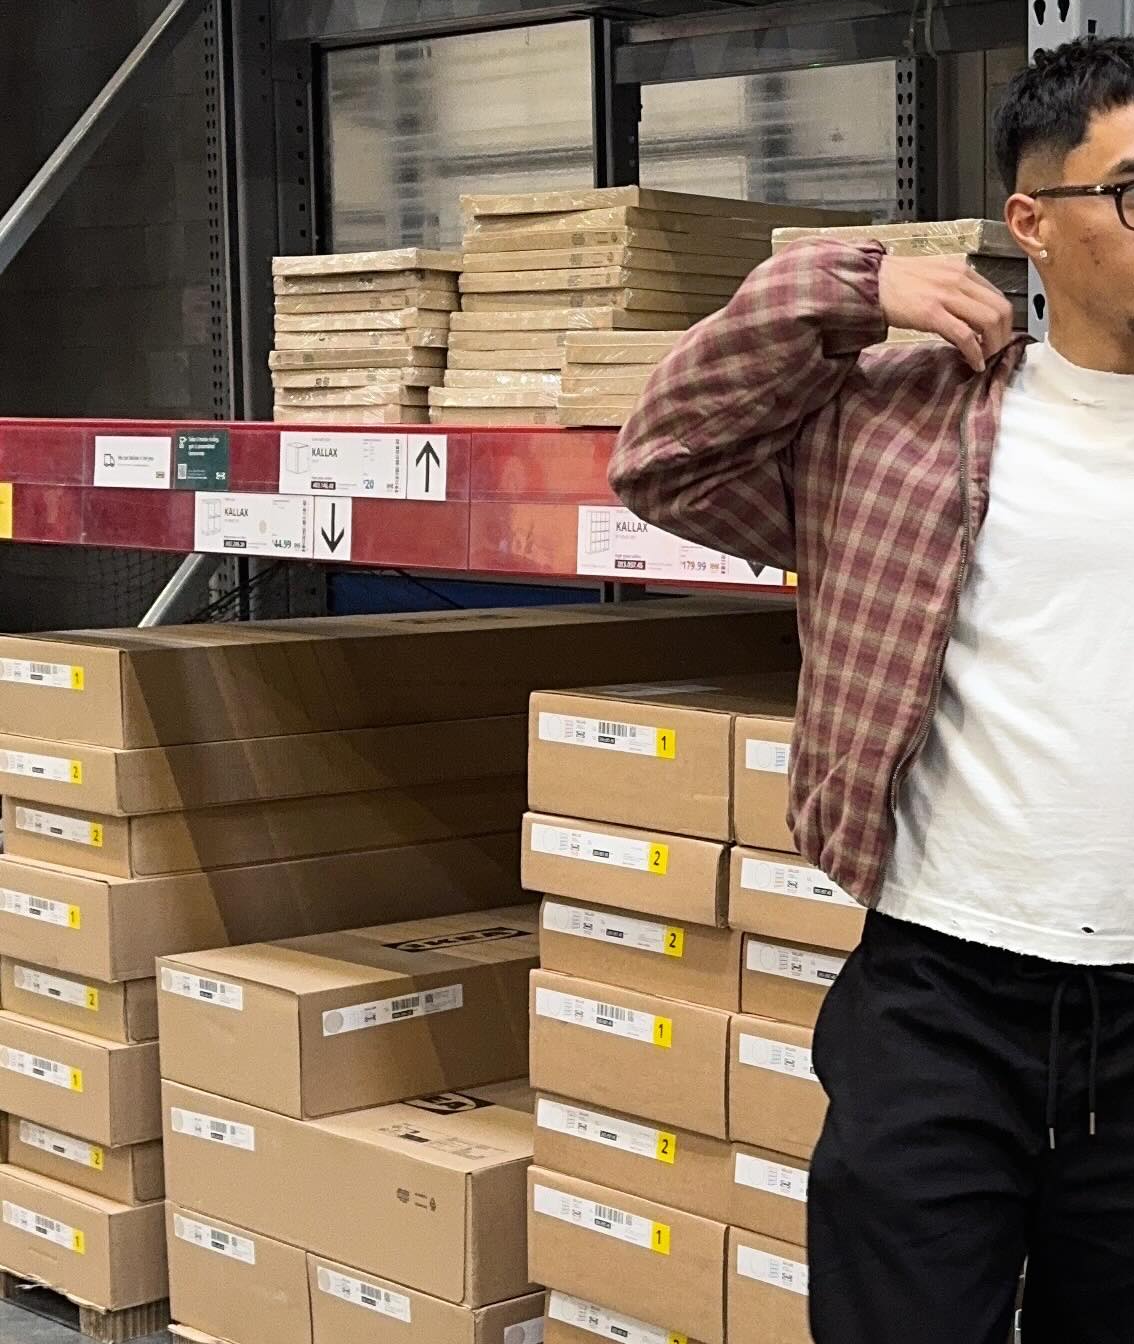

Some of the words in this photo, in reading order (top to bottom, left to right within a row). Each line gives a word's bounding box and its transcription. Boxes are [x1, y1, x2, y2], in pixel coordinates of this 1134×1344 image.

[311, 447, 338, 458] KALLAX
[224, 507, 249, 517] KALLAX
[615, 520, 648, 533] KALLAX
[661, 736, 666, 750] 1
[653, 850, 661, 866] 2
[669, 932, 677, 948] 2
[658, 1023, 664, 1038] 1
[662, 1139, 669, 1154] 2
